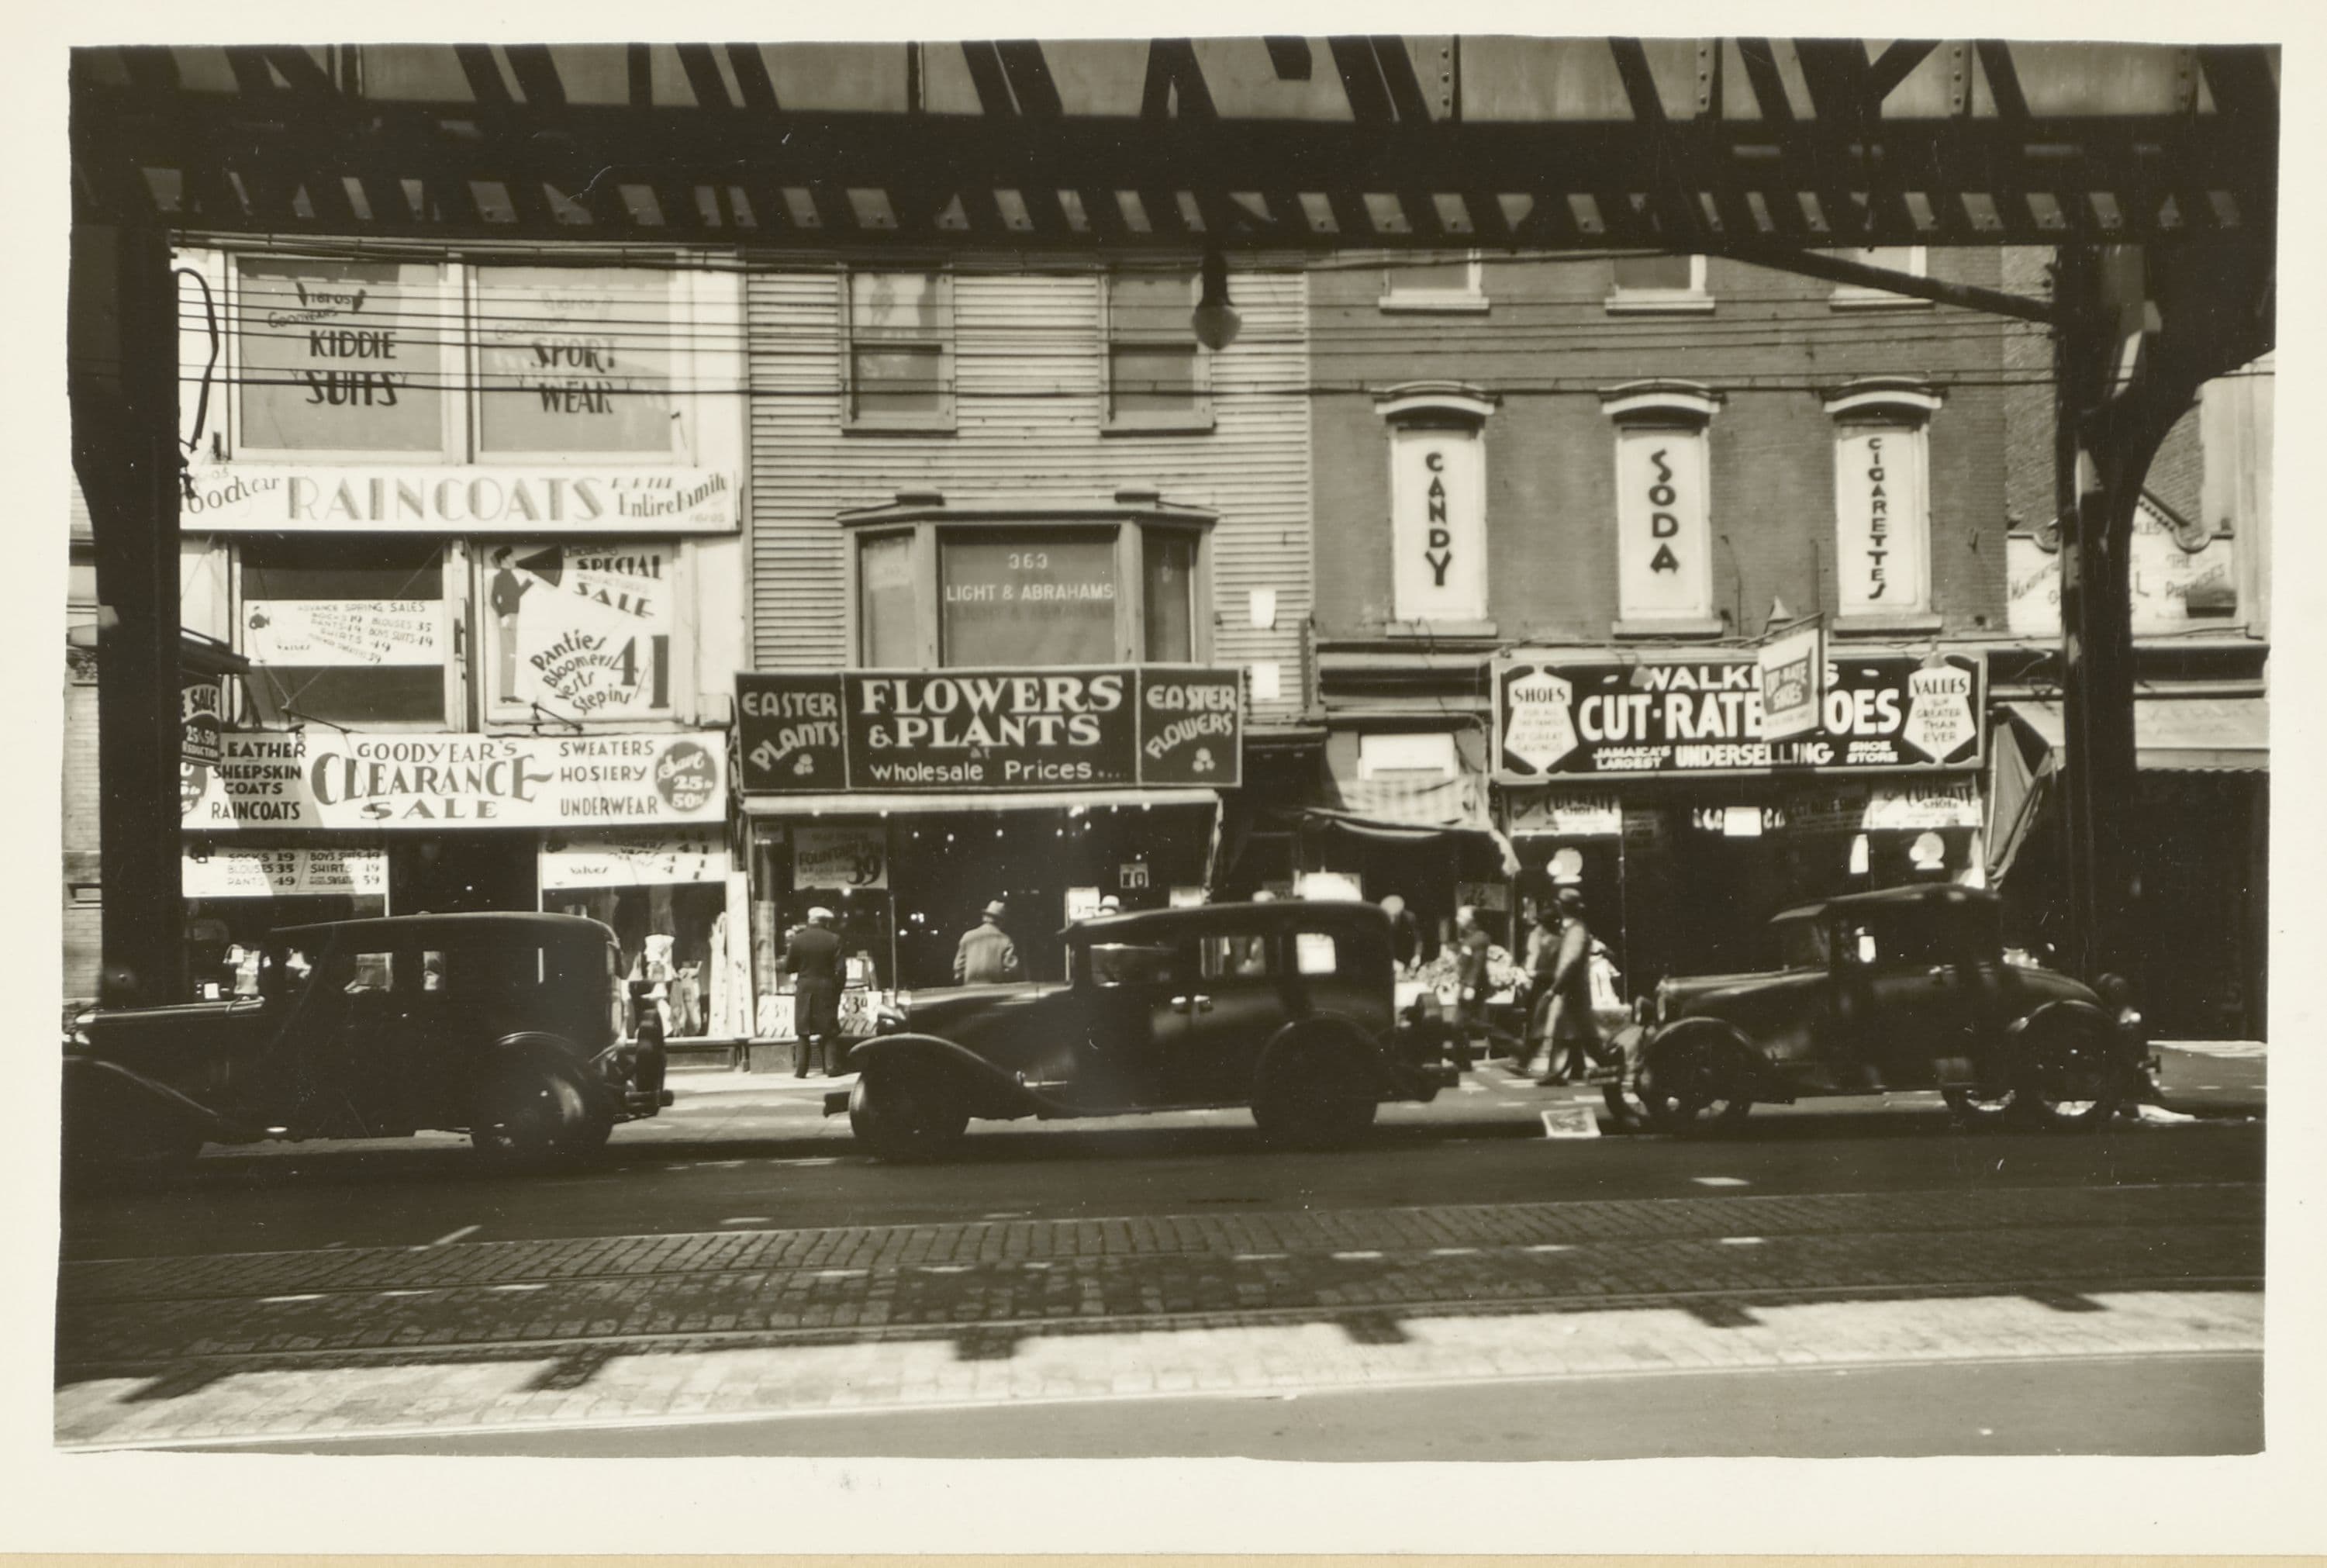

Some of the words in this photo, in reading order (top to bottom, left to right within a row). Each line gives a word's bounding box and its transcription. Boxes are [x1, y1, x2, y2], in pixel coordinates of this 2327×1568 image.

[310, 330, 397, 359] KIDDIE
[530, 338, 616, 374] SPORT
[306, 371, 398, 406] SUITS
[537, 381, 613, 413] WEAR
[287, 476, 603, 522] RAINCOATS
[1649, 449, 1680, 574] SODA
[1424, 452, 1452, 586] CANDY
[1867, 437, 1888, 600] CIGARETTES
[576, 554, 663, 580] SPECIAL
[1008, 553, 1048, 569] 363
[572, 582, 655, 619] SALE
[945, 585, 996, 602] LIGHT
[1002, 585, 1013, 600] &
[1021, 582, 1114, 600] ABRAHAMS
[390, 602, 426, 613] SALES
[529, 629, 607, 672] Panties
[542, 652, 613, 689] Bloomers
[554, 671, 595, 702] Vests
[861, 674, 1124, 715] FLOWERS
[1146, 684, 1238, 711] EASTER
[1514, 686, 1566, 703] SHOES
[1913, 677, 1967, 696] VALUES
[741, 691, 838, 719] EASTER
[868, 724, 893, 748] &
[895, 713, 1101, 748] PLANTS
[1145, 712, 1233, 760] FLOWERS
[1923, 731, 1956, 743] EVER
[220, 741, 306, 758] EATHER
[357, 739, 518, 763] GOODYEAR'S
[559, 740, 654, 758] SWEATERS
[749, 720, 841, 772] PLANTS
[1592, 745, 1671, 759] JAMAICA'S
[1675, 741, 1835, 768] UNDERSELLING
[1845, 751, 1899, 765] STORE
[1849, 741, 1893, 753] SHOE
[212, 764, 302, 780] SHEEPSKIN
[561, 765, 647, 782] HOSIERY
[870, 761, 984, 782] Wholesale
[1597, 757, 1662, 770] LARGEST
[225, 782, 282, 795] COATS
[311, 751, 554, 806] CLEARANCE
[212, 800, 301, 820] RAINCOATS
[360, 797, 499, 820] SALE
[561, 795, 658, 817] UNDERWEAR
